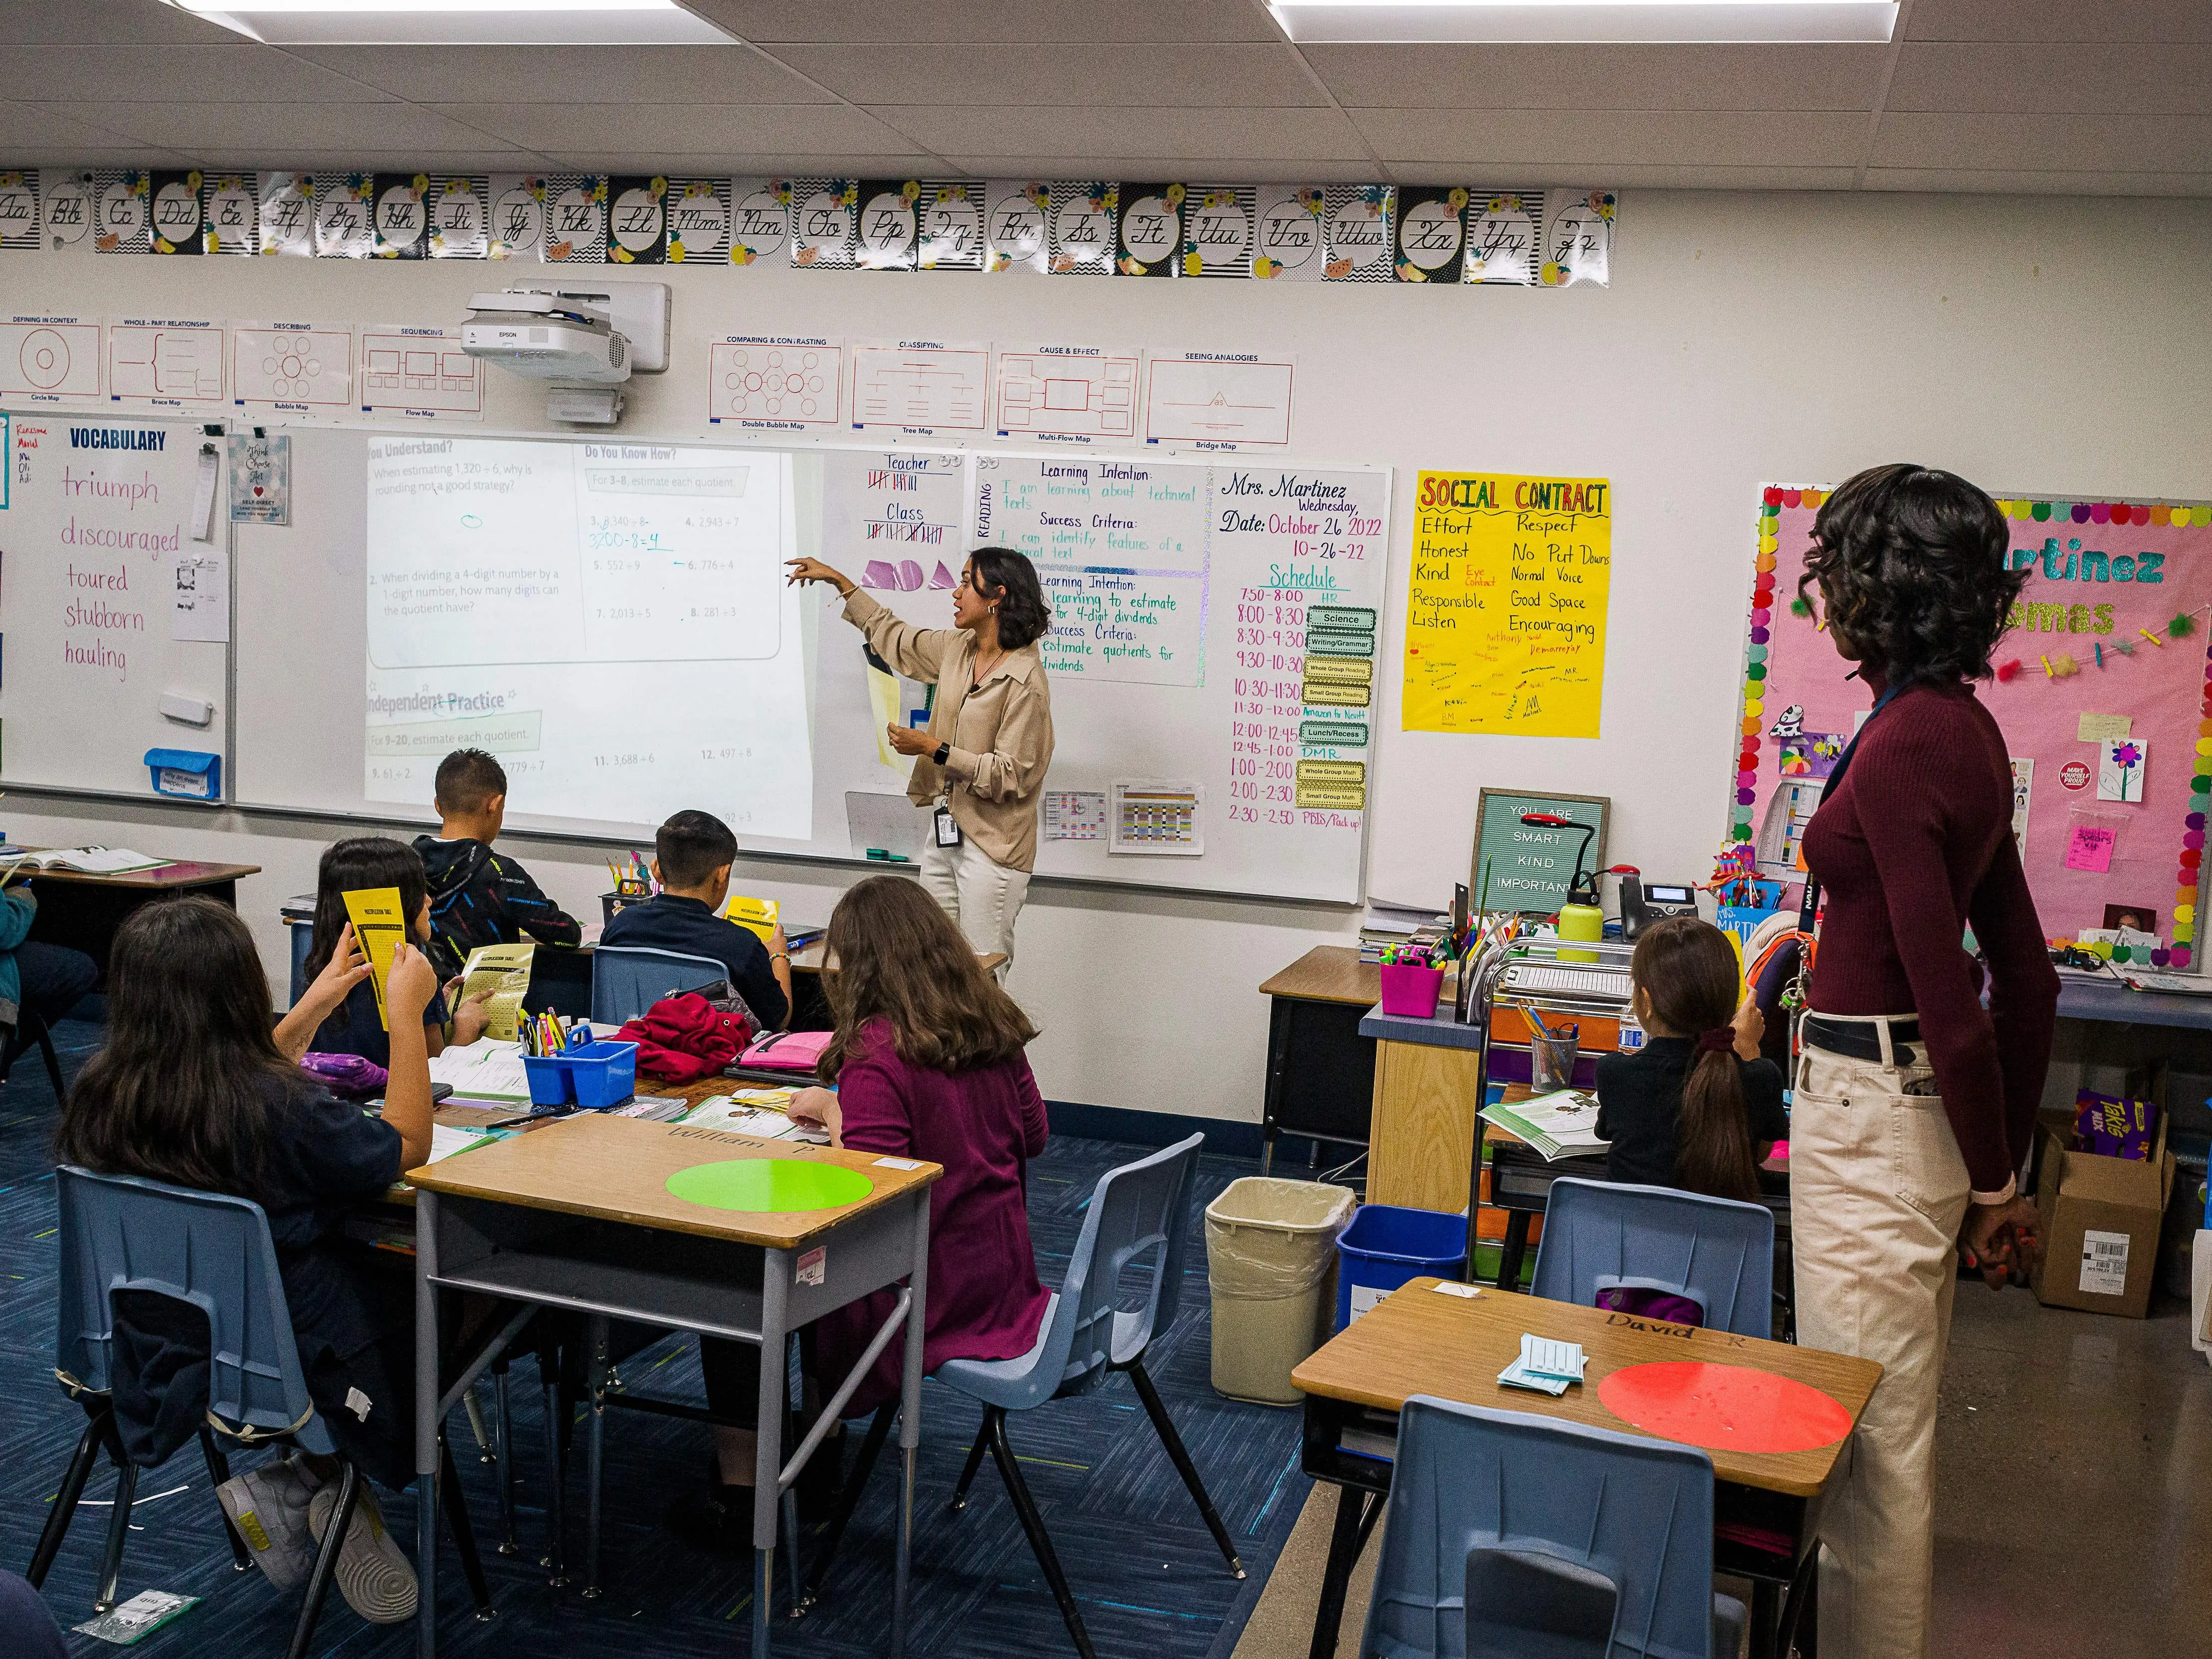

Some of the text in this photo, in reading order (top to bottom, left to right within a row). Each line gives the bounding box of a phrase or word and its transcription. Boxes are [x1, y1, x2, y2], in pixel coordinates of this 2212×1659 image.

[51, 199, 83, 225] Bb
[160, 200, 195, 224] Dd
[325, 202, 358, 239] Gg
[561, 205, 592, 231] Kk
[677, 210, 723, 229] Mm
[870, 211, 904, 250] Pp
[777, 337, 826, 346] CONTRASTING
[70, 428, 166, 451] VOCABULARY
[385, 440, 453, 457] Understand?
[1075, 435, 1091, 444] Map
[247, 444, 268, 457] Think
[601, 446, 676, 460] You Know How?
[246, 457, 271, 470] Choose
[374, 464, 481, 479] When 1,320
[884, 454, 931, 470] Teacher
[1042, 462, 1152, 486] Learning Intention:
[62, 466, 158, 510] triumph
[1048, 481, 1195, 503] learning about technical
[1221, 472, 1346, 498] Mrs. Martinez
[1421, 477, 1607, 513] SOCIAL CONTRACT
[887, 503, 924, 520] Class
[1299, 500, 1359, 517] Wednesday,
[1040, 512, 1137, 529] Success Criteria:
[1219, 510, 1381, 536] Date: October 26 2022
[1422, 517, 1472, 535] Effort
[1517, 514, 1578, 538] Respect
[61, 517, 179, 560] discouraged
[1052, 531, 1148, 550] identify features
[1421, 540, 1469, 558] Honest
[1513, 543, 1609, 565] No Put Downs
[66, 564, 127, 590] toured
[499, 569, 536, 578] number
[1270, 563, 1337, 588] Schedule
[1417, 563, 1449, 580] Kind
[1466, 564, 1484, 576] Eye
[1512, 567, 1583, 583] Normal Voice
[1040, 573, 1135, 595] Learning Intention:
[1053, 590, 1176, 612] learning to estimate
[1413, 588, 1485, 612] Responsible
[1512, 590, 1586, 612] Good Space
[64, 597, 144, 630] stubborn
[1056, 604, 1157, 624] for dividends
[1324, 614, 1359, 623] Science
[1413, 611, 1455, 628] Listen
[1095, 624, 1136, 641] Criteria:
[1510, 615, 1595, 643] Encouraging
[1042, 637, 1173, 663] estimate quotients for
[1311, 639, 1368, 648] Writing/Grammar
[66, 638, 126, 683] hauling
[1042, 657, 1084, 671] dividends
[447, 691, 504, 711] Practice
[613, 754, 638, 766] 3,688
[1302, 748, 1341, 759] DMR
[1514, 832, 1562, 845] SMART
[1518, 855, 1554, 868] KIND
[1718, 907, 1736, 920] MRS.
[2100, 1101, 2126, 1137] Takis
[667, 1127, 765, 1148] William
[1606, 1313, 1695, 1339] David
